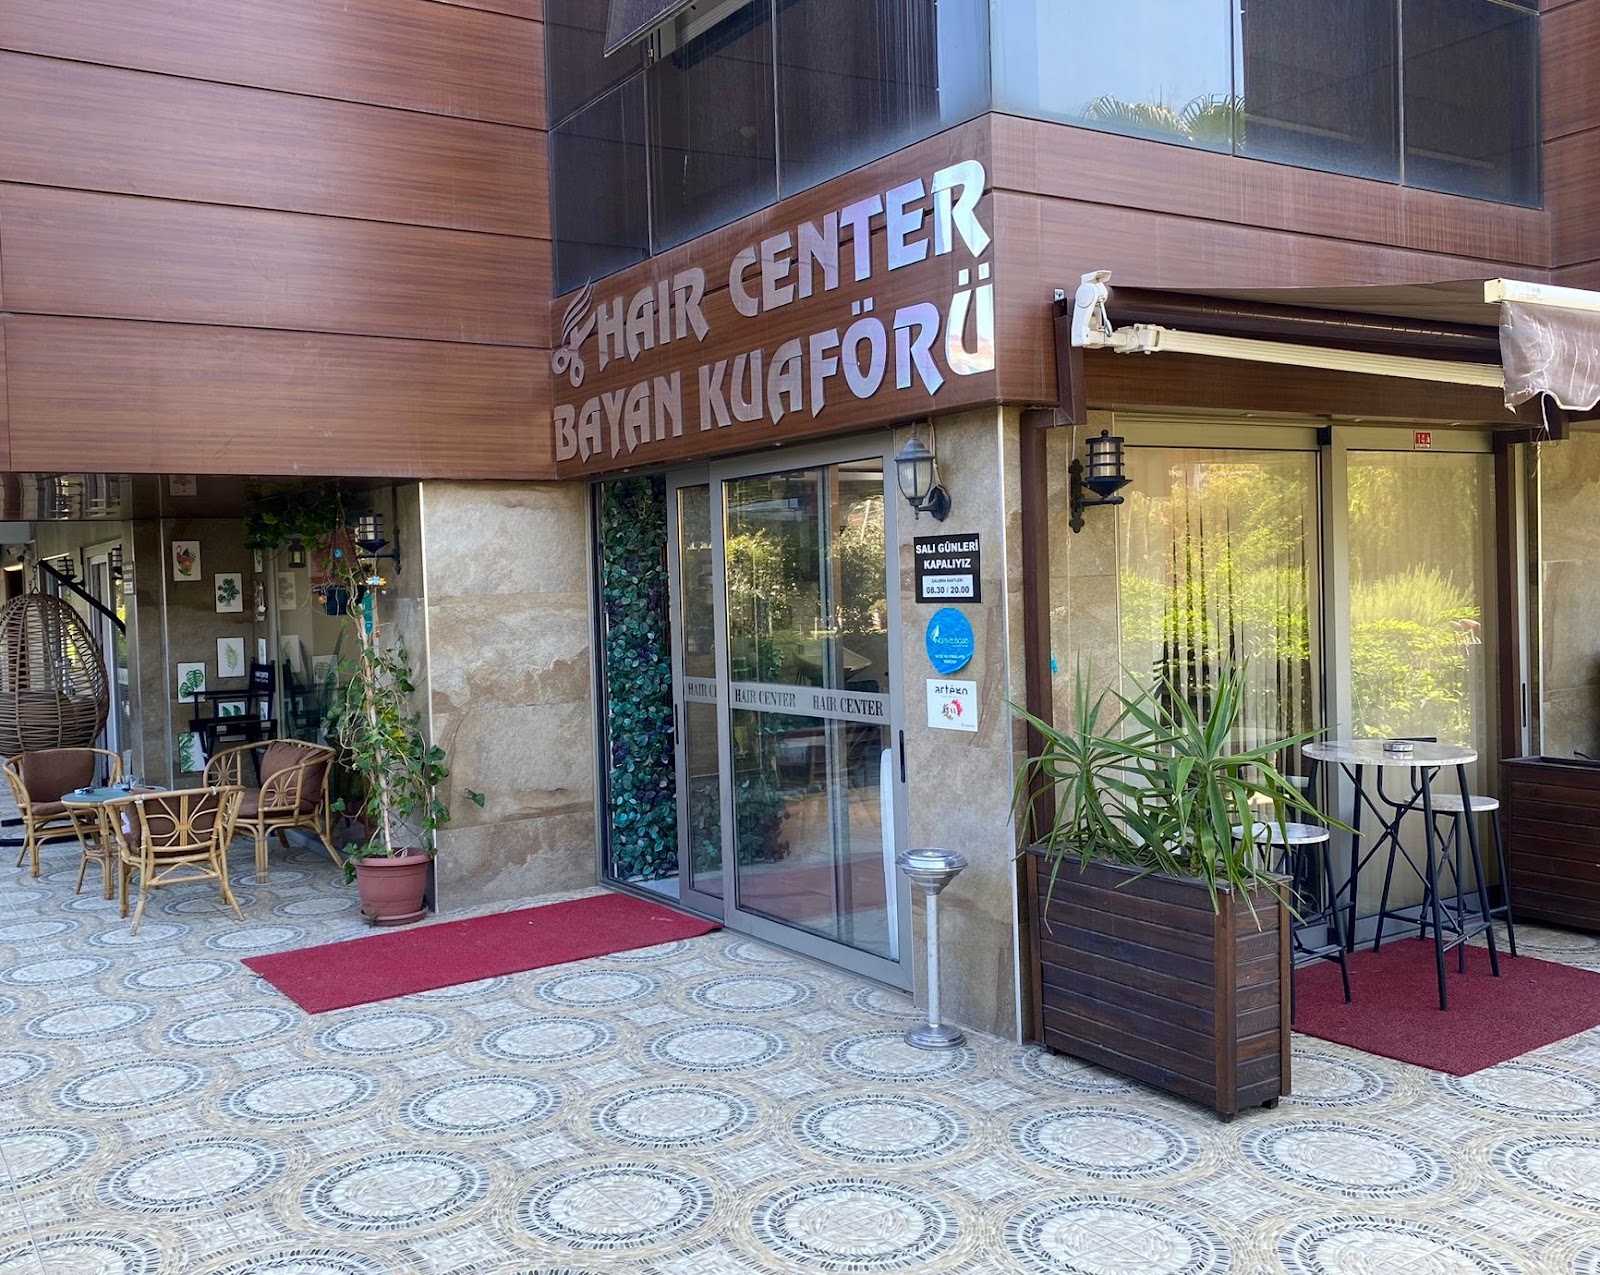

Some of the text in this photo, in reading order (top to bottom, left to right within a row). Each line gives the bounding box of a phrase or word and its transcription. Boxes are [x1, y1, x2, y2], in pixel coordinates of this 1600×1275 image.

[597, 159, 991, 372] HAIR CENTER
[553, 262, 996, 463] BAYAN KUAFÖRÜ
[916, 539, 978, 554] SALI GÜNLERİ
[924, 559, 971, 569] KAPALIYIZ
[688, 683, 707, 697] HAIR
[735, 689, 796, 708] HAIR CENTER
[813, 696, 883, 717] HAIR CENTER
